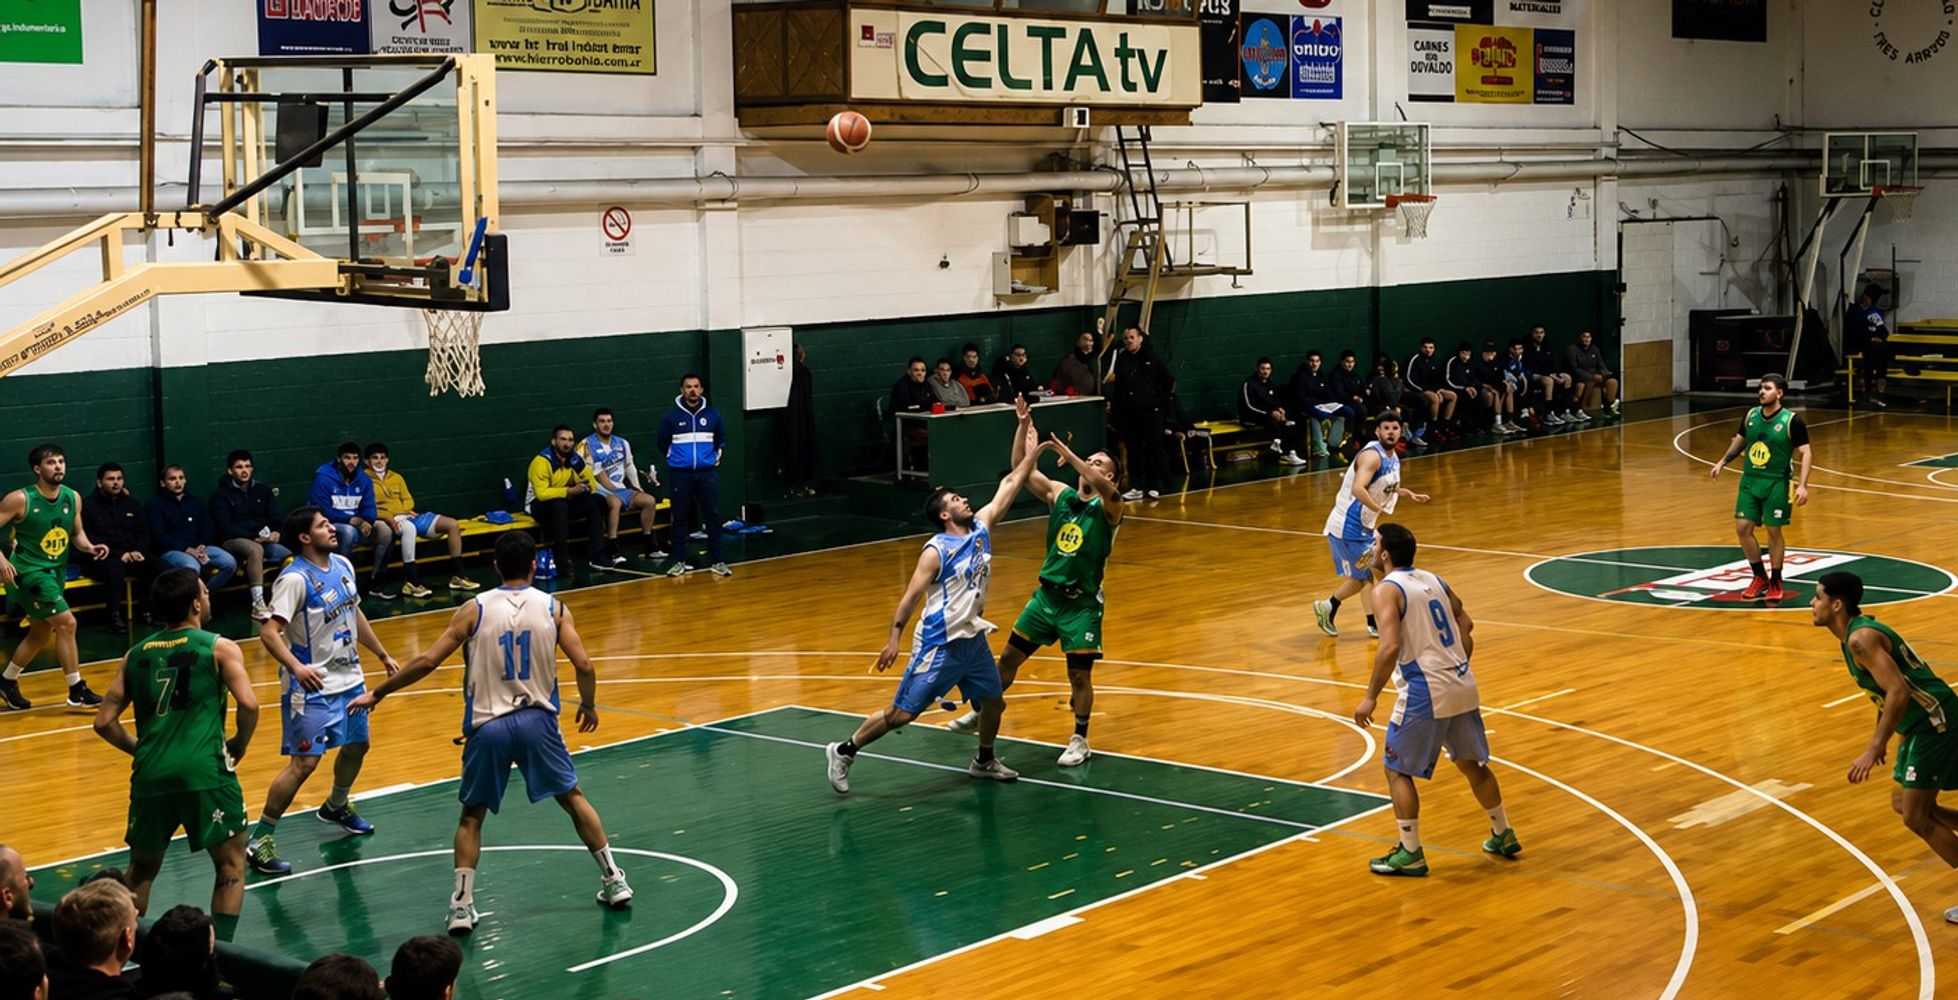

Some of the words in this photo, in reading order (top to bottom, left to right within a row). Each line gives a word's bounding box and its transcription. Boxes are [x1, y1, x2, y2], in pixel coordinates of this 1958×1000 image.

[904, 20, 1111, 92] CELTA
[1114, 32, 1168, 93] tv
[1413, 40, 1449, 52] CARNES
[1429, 598, 1455, 648] 9
[499, 630, 531, 680] 11
